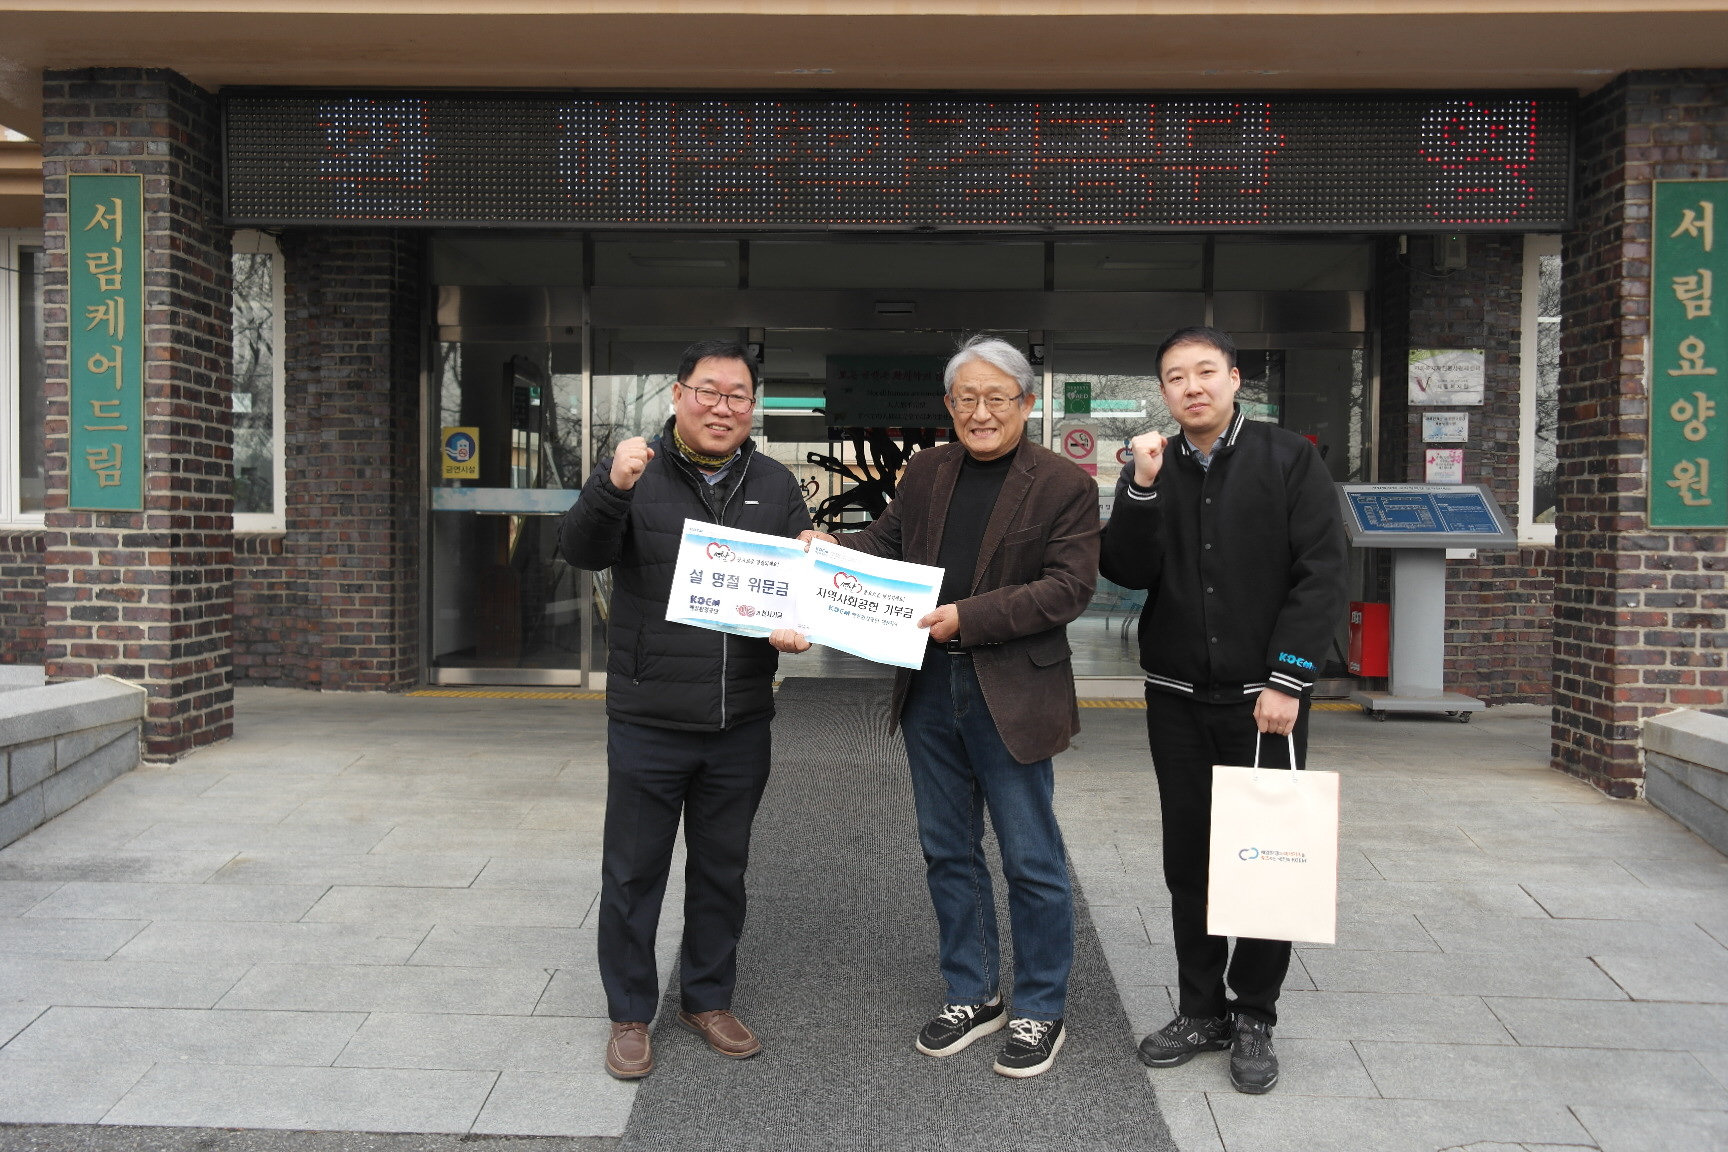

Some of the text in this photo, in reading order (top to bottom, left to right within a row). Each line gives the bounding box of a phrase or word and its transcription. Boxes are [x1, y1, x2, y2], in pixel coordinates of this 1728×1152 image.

[318, 98, 1538, 224] 환 해양환경공단 영
[84, 197, 128, 488] 서림케어드림
[1666, 201, 1718, 506] 서림요양원
[446, 465, 476, 474] 금연시설
[689, 569, 789, 597] 설 명절 위문금
[690, 594, 721, 607] KOEM
[815, 586, 914, 619] 지역사회공헌 기부금
[828, 604, 851, 616] KOEM
[1279, 651, 1312, 669] KOEM
